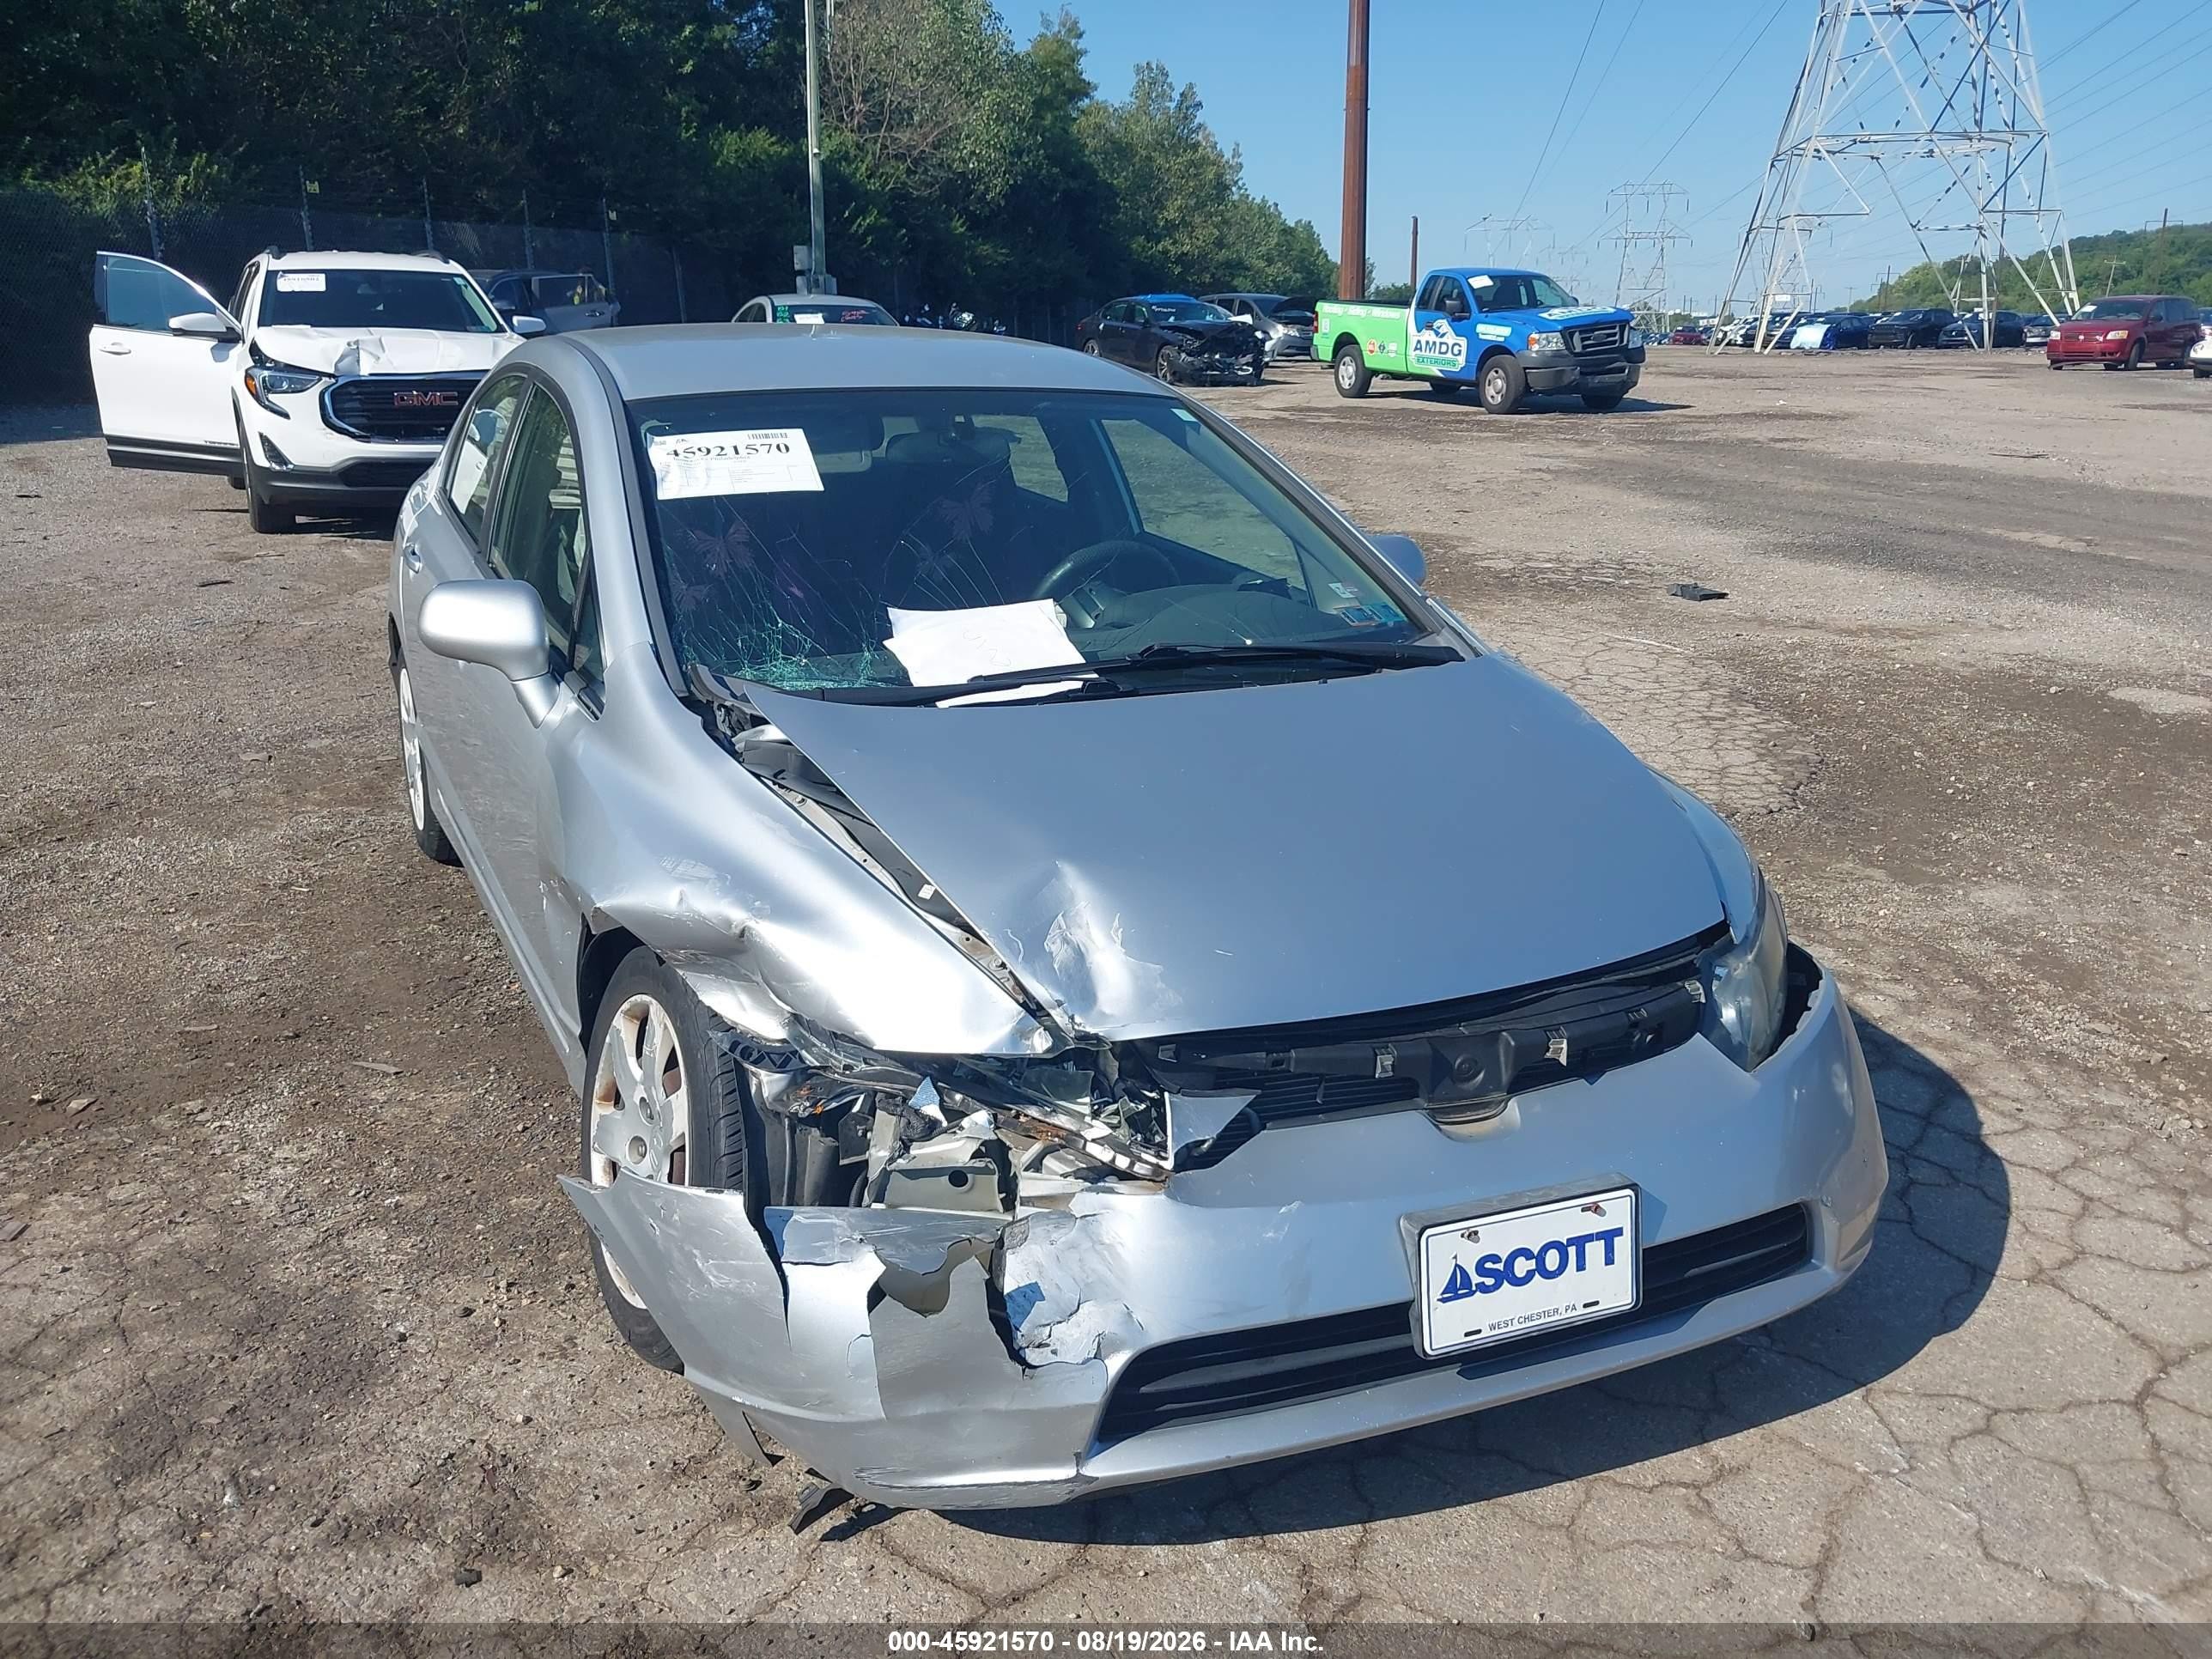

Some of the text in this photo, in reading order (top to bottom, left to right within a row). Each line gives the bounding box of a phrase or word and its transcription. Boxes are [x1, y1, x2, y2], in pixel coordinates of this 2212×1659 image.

[1413, 339, 1462, 356] AMDG
[1416, 356, 1457, 367] EXTERIORS
[393, 392, 459, 406] GMC
[666, 443, 790, 459] 45921570
[1474, 1226, 1623, 1294] SCOTT
[1488, 1304, 1577, 1332] WEST CHESTER, PA
